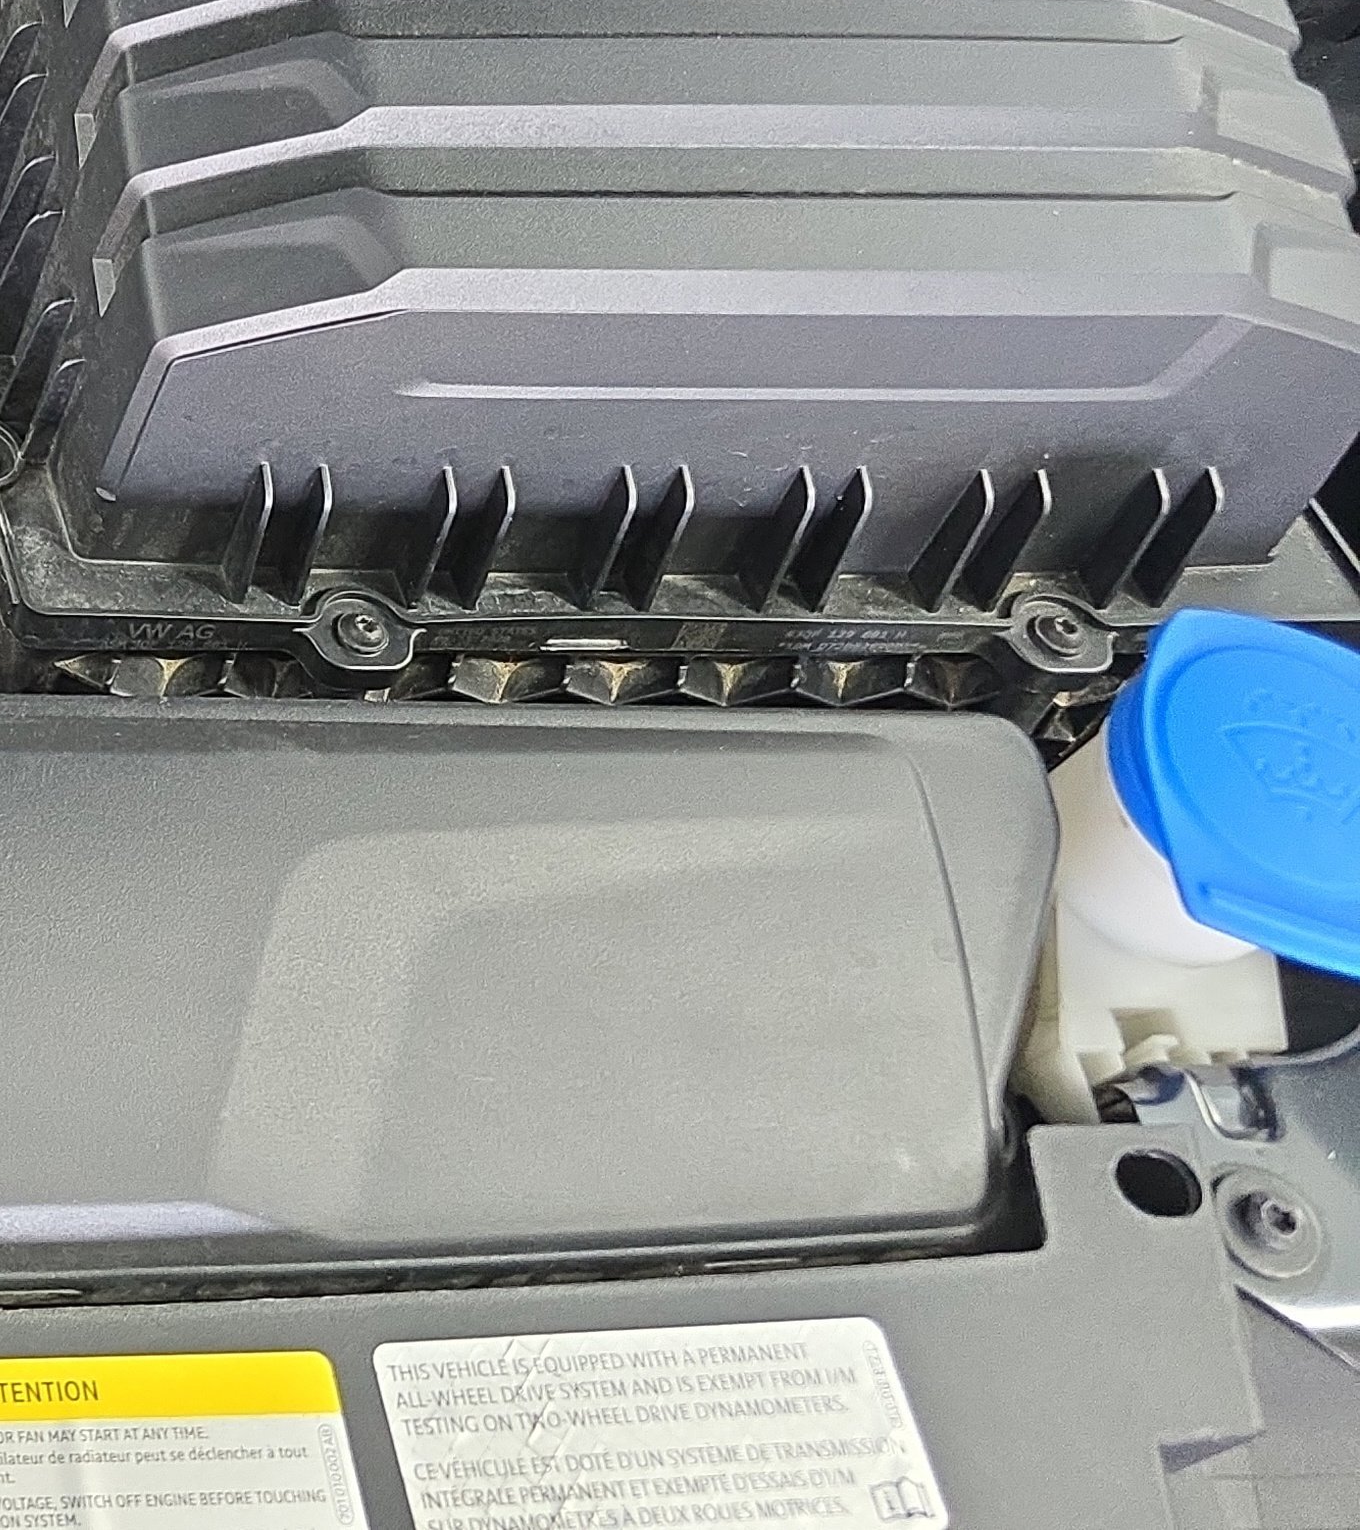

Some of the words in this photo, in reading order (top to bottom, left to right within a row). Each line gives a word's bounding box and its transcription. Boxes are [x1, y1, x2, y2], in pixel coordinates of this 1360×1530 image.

[130, 623, 173, 638] VW
[176, 624, 216, 639] AG
[387, 1363, 430, 1382] THIS
[432, 1358, 508, 1379] VEHICLE
[515, 1358, 528, 1375] IS
[533, 1353, 624, 1377] EQUIPPED
[627, 1350, 677, 1369] WITH
[682, 1349, 697, 1366] A
[699, 1342, 809, 1365] PERMANENT
[397, 1386, 497, 1409] ALL-WHEEL
[501, 1384, 556, 1403] DRIVE
[560, 1380, 628, 1400] SYSTEM
[632, 1378, 673, 1396] AND
[679, 1377, 695, 1393] IS
[698, 1372, 766, 1393] EXEMPT
[772, 1370, 821, 1388] FROM
[401, 1416, 479, 1436] TESTING
[483, 1415, 513, 1432] ON
[517, 1407, 632, 1431] TWO-WHEEL
[635, 1404, 689, 1423] DRIVE
[693, 1395, 849, 1420] DYNAMOMETERS.
[18, 1431, 44, 1443] FAN
[48, 1429, 76, 1443] MAY
[81, 1428, 120, 1442] START
[123, 1428, 139, 1440] AT
[142, 1428, 169, 1440] ANY
[173, 1427, 209, 1440] TIME.
[50, 1451, 65, 1464] de
[69, 1449, 132, 1464] radiateur
[135, 1450, 165, 1464] peut
[170, 1451, 185, 1461] se
[189, 1446, 262, 1461] déclencher
[267, 1446, 274, 1459] à
[279, 1447, 307, 1459] tout
[414, 1463, 438, 1481] CE
[439, 1457, 527, 1480] VÉHICULE
[533, 1454, 560, 1475] EST
[565, 1450, 615, 1472] DOTÉ
[617, 1450, 664, 1468] D'UN
[667, 1443, 747, 1466] SYSTÈME
[771, 1437, 906, 1461] TRANSMISSION
[61, 1495, 113, 1509] SWITCH
[117, 1494, 141, 1507] OFF
[146, 1493, 199, 1507] ENGINE
[200, 1491, 252, 1506] BEFORE
[257, 1489, 327, 1503] TOUCHING
[422, 1486, 517, 1509] INTÉGRALE
[521, 1480, 629, 1505] PERMANENT
[631, 1479, 649, 1497] ET
[24, 1514, 81, 1527] SYSTEM.
[638, 1505, 690, 1526] DEUX
[694, 1501, 754, 1522] ROUES
